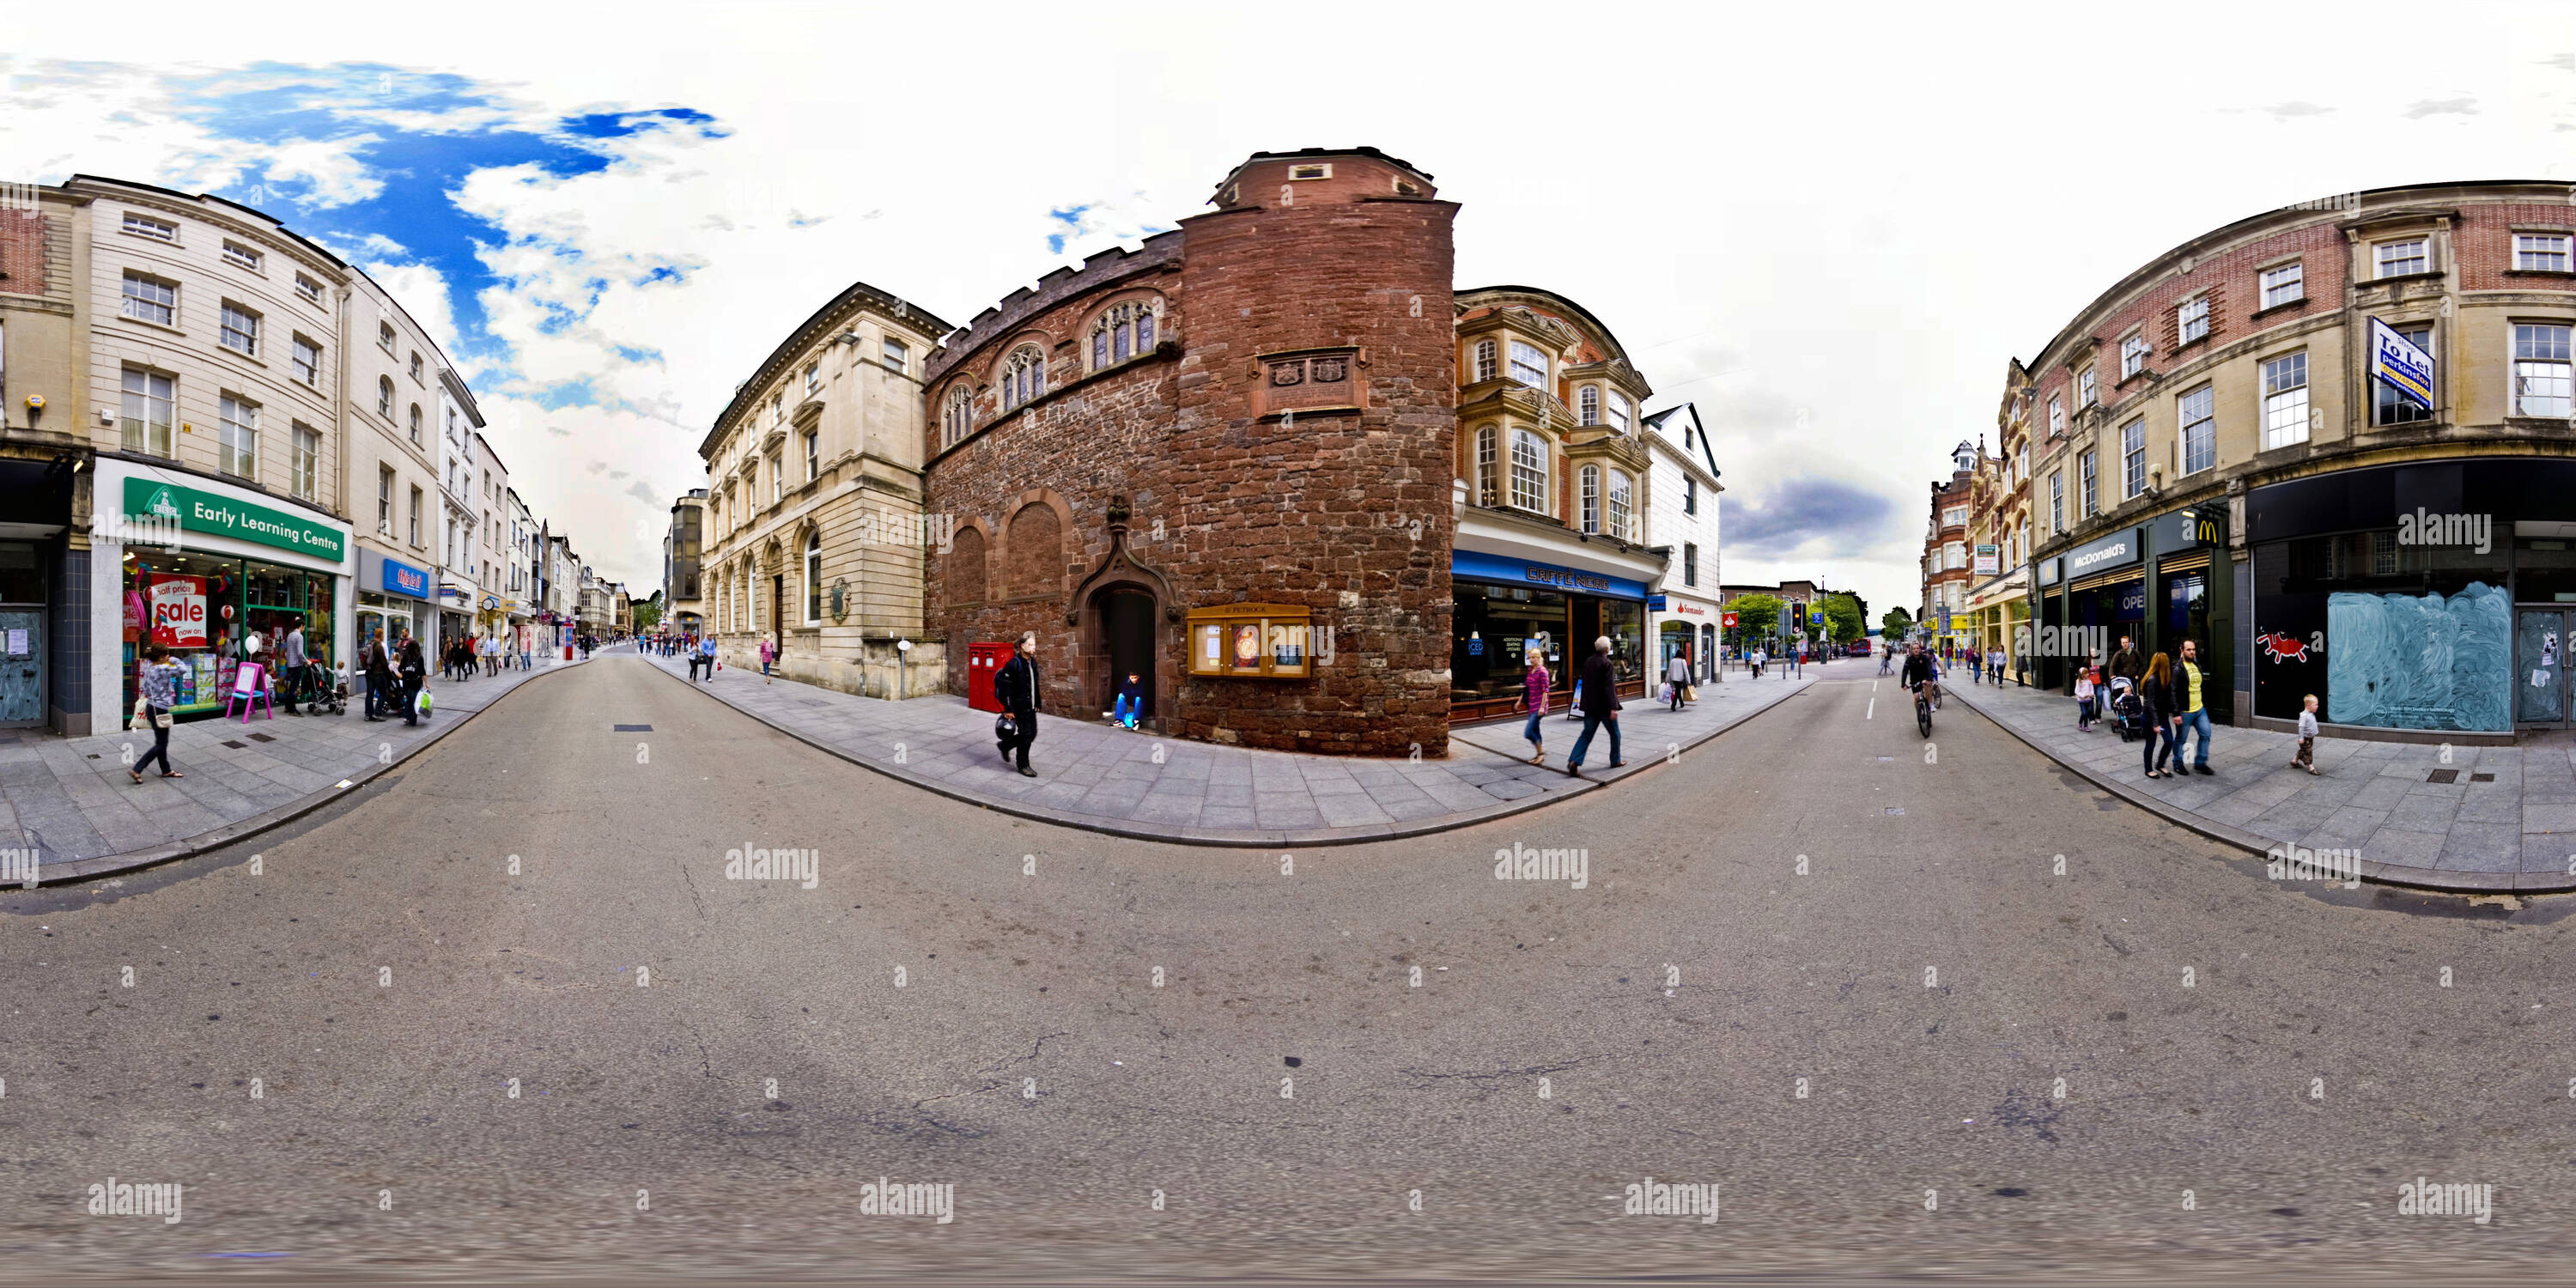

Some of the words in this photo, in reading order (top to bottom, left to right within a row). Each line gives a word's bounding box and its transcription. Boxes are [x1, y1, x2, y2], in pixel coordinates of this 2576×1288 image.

[2397, 337, 2416, 354] Shop
[2379, 332, 2401, 358] To
[2407, 350, 2432, 378] Let
[2382, 354, 2429, 388] perkinsfox
[195, 501, 236, 528] Early
[241, 512, 300, 543] Learning
[303, 530, 338, 551] Centre
[2074, 543, 2126, 569] McDonald's
[173, 585, 191, 594] price
[1576, 574, 1609, 591] NERO
[155, 597, 204, 623] sale
[1684, 605, 1704, 616] Santander
[2123, 595, 2144, 610] OPE
[123, 608, 137, 619] ale
